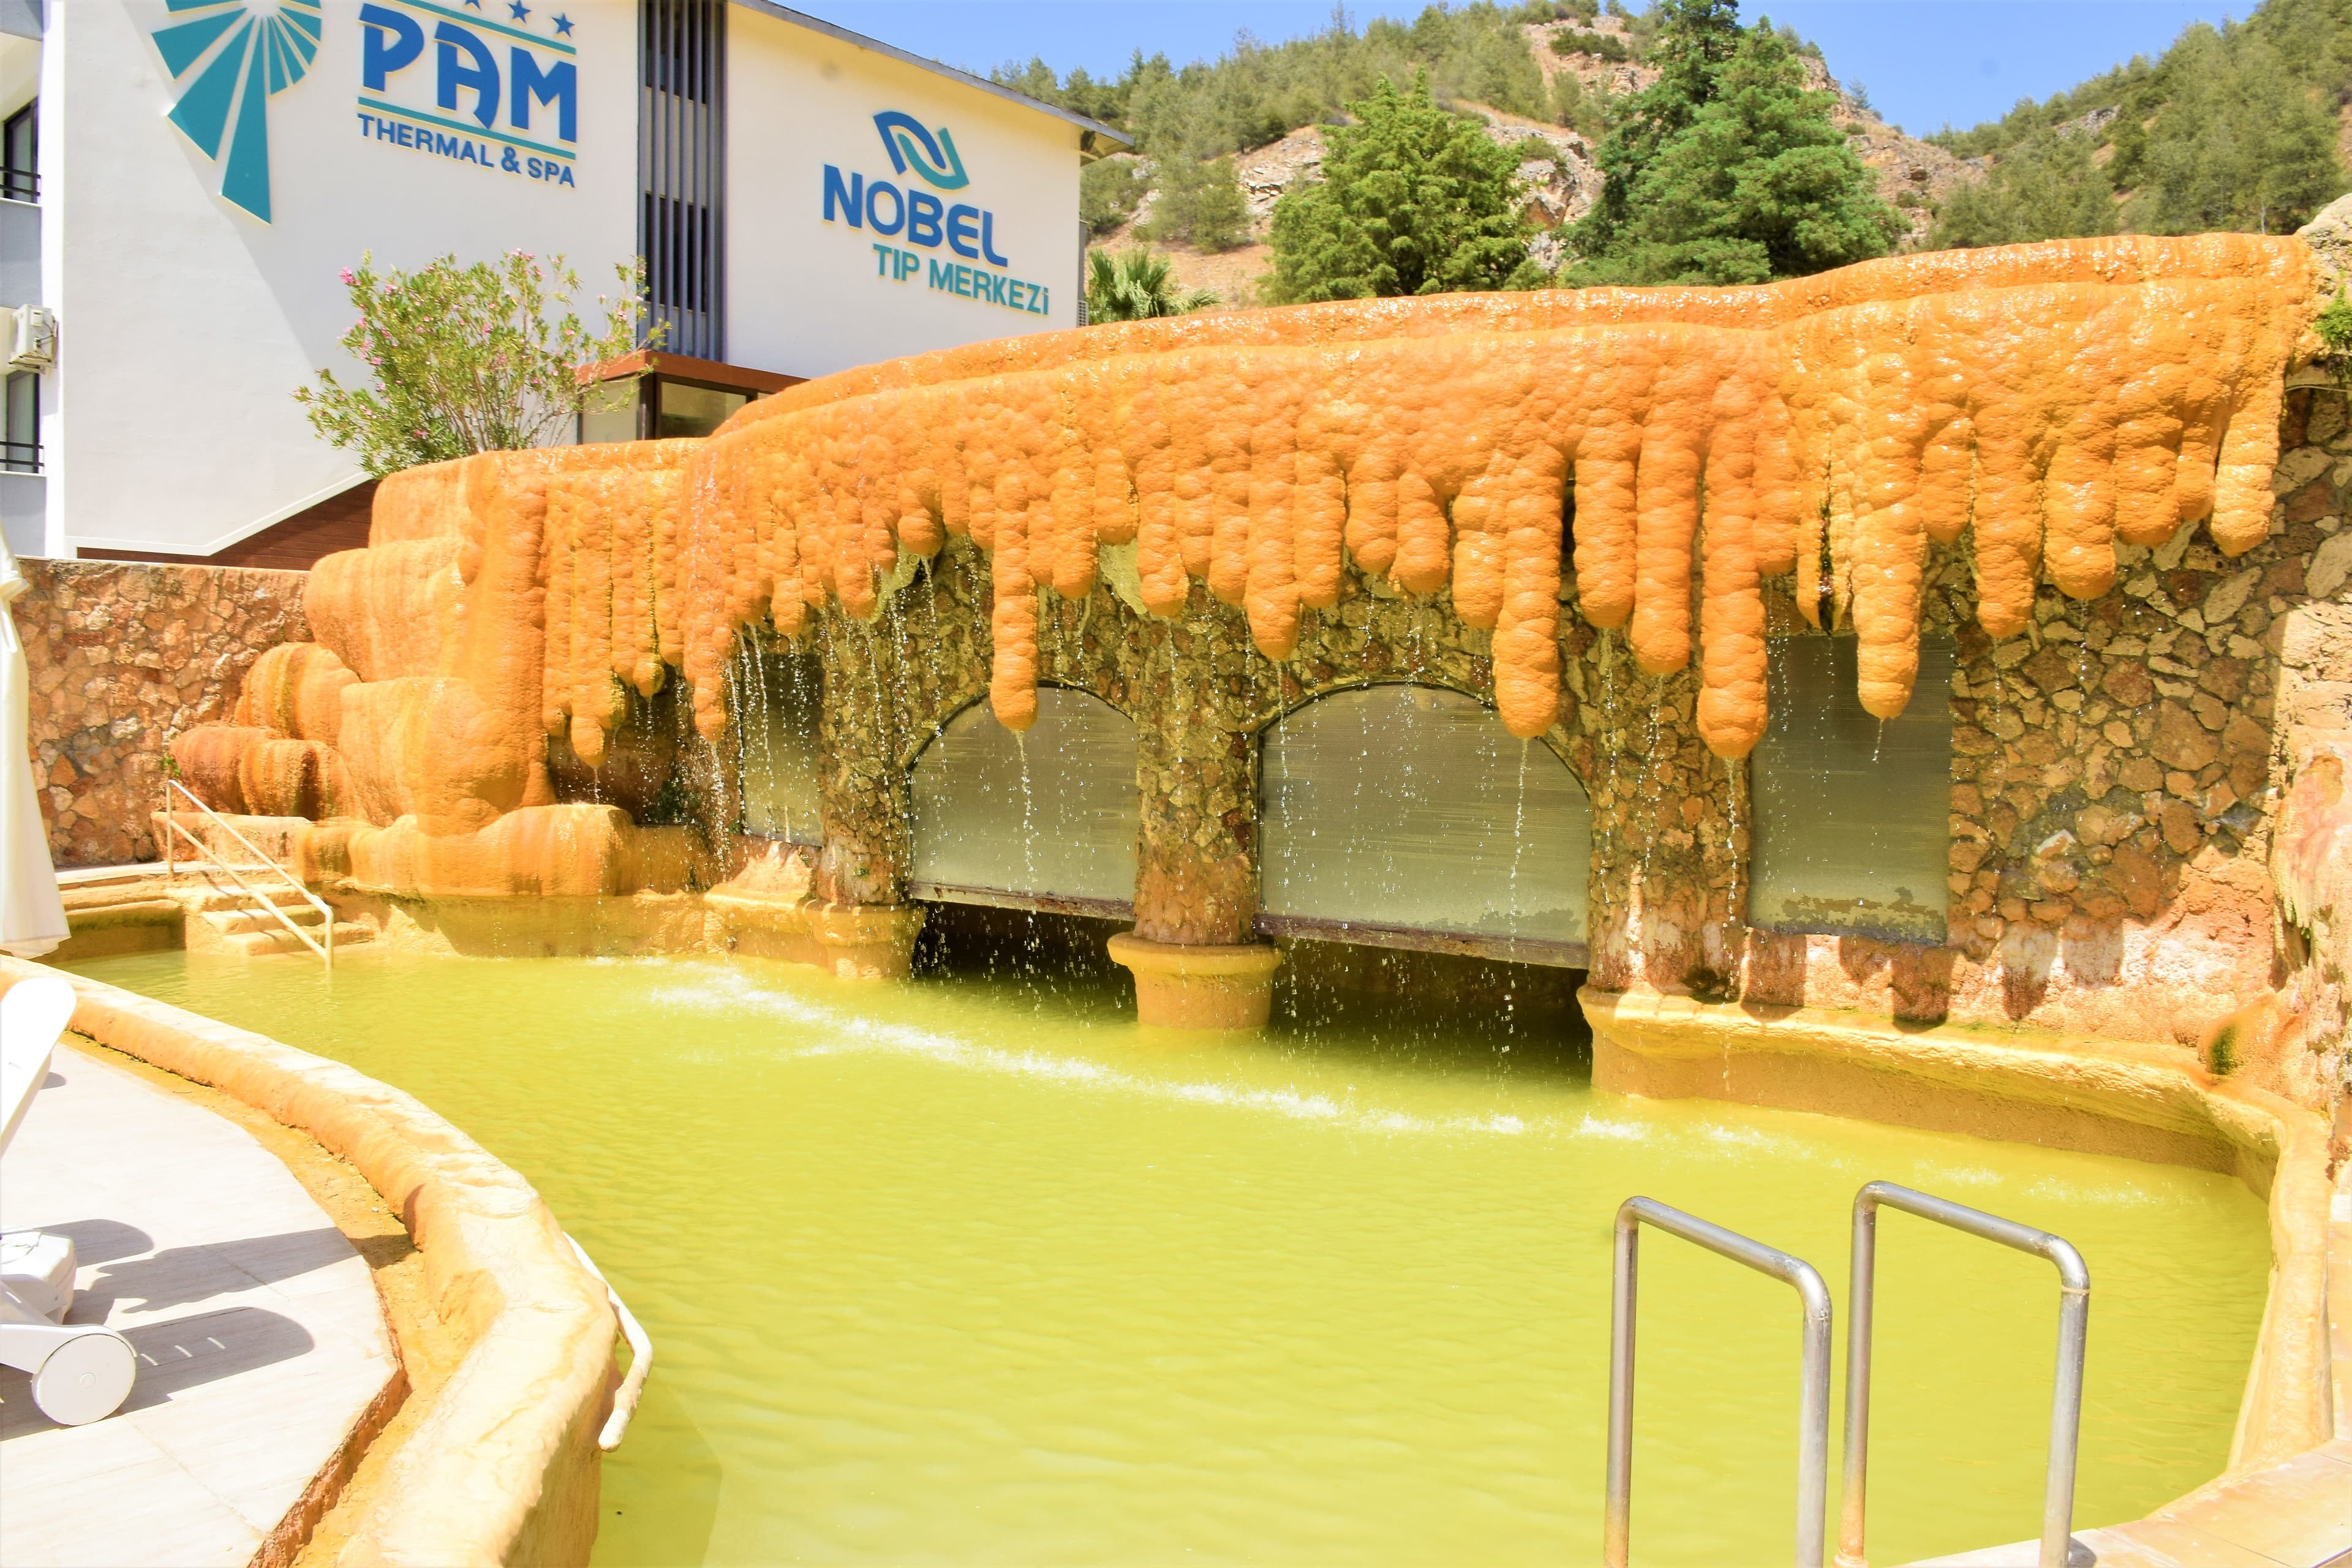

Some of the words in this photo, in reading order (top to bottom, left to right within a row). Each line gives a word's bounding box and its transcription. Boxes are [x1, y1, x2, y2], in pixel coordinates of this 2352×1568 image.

[359, 3, 576, 143] PAM
[358, 113, 494, 167] THERMAL
[501, 146, 521, 174] &
[527, 157, 575, 188] SPA
[824, 164, 1008, 268] NOBEL
[873, 243, 920, 281] TIP
